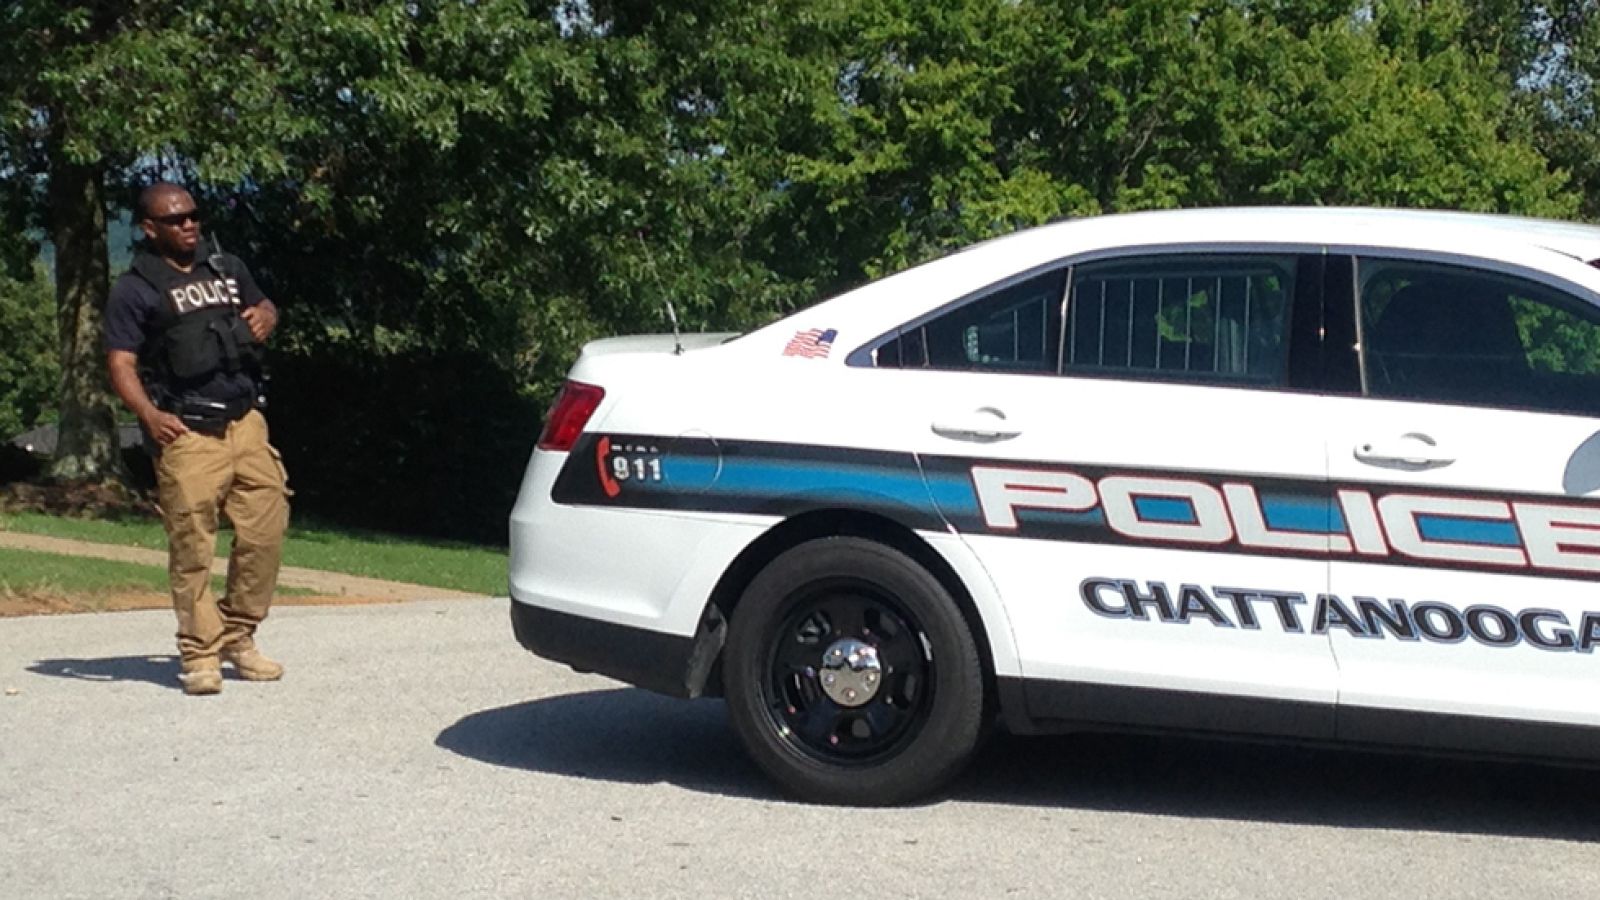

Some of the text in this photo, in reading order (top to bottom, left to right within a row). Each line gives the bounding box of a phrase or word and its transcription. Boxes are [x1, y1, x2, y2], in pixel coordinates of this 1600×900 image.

[170, 278, 241, 313] POLICE
[613, 456, 661, 480] 911
[970, 465, 1600, 568] POLICE
